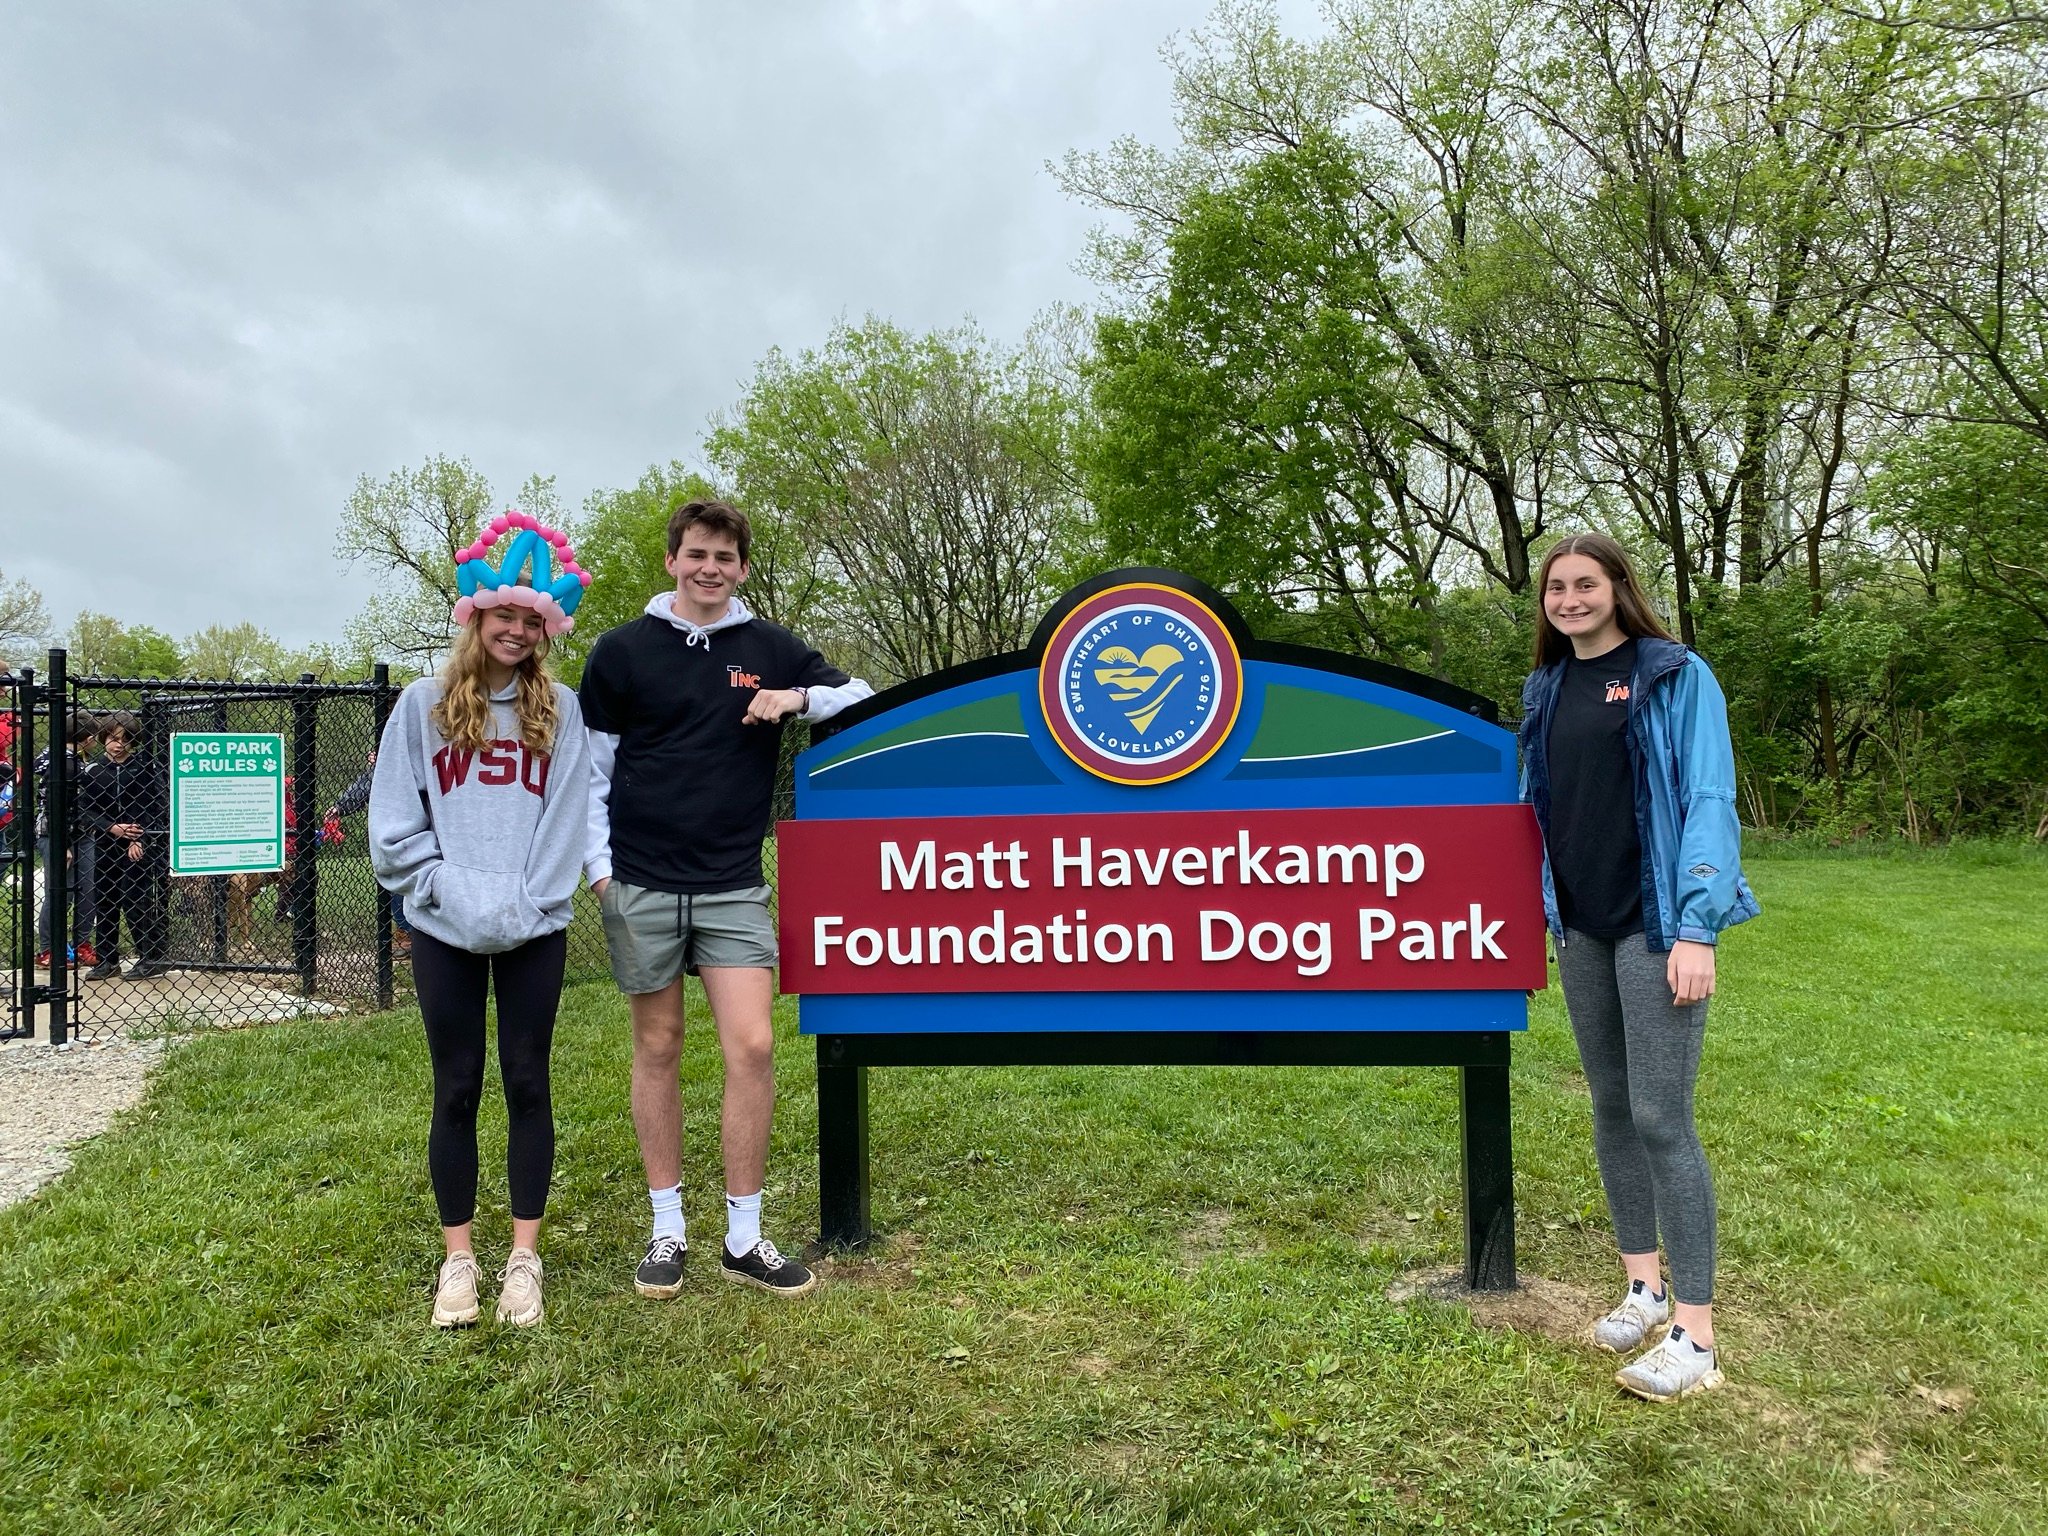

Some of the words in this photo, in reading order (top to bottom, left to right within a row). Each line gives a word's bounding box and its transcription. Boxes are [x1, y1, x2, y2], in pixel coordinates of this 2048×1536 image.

[726, 664, 761, 689] TNC
[1070, 619, 1119, 714] SWEETHEART
[1131, 615, 1153, 626] OF
[1164, 621, 1200, 652] OHIO
[1196, 673, 1211, 712] 1876
[1605, 680, 1630, 703] TN
[181, 741, 221, 755] DOG
[226, 741, 273, 755] PARK
[1097, 729, 1187, 753] LOVELAND
[198, 758, 258, 772] RULES
[432, 738, 552, 798] WSU
[880, 839, 1030, 891] Matt
[1052, 829, 1426, 898] Haverkamp
[813, 909, 1175, 966] Foundation
[1199, 909, 1333, 977] Dog
[1359, 903, 1509, 961] Park
